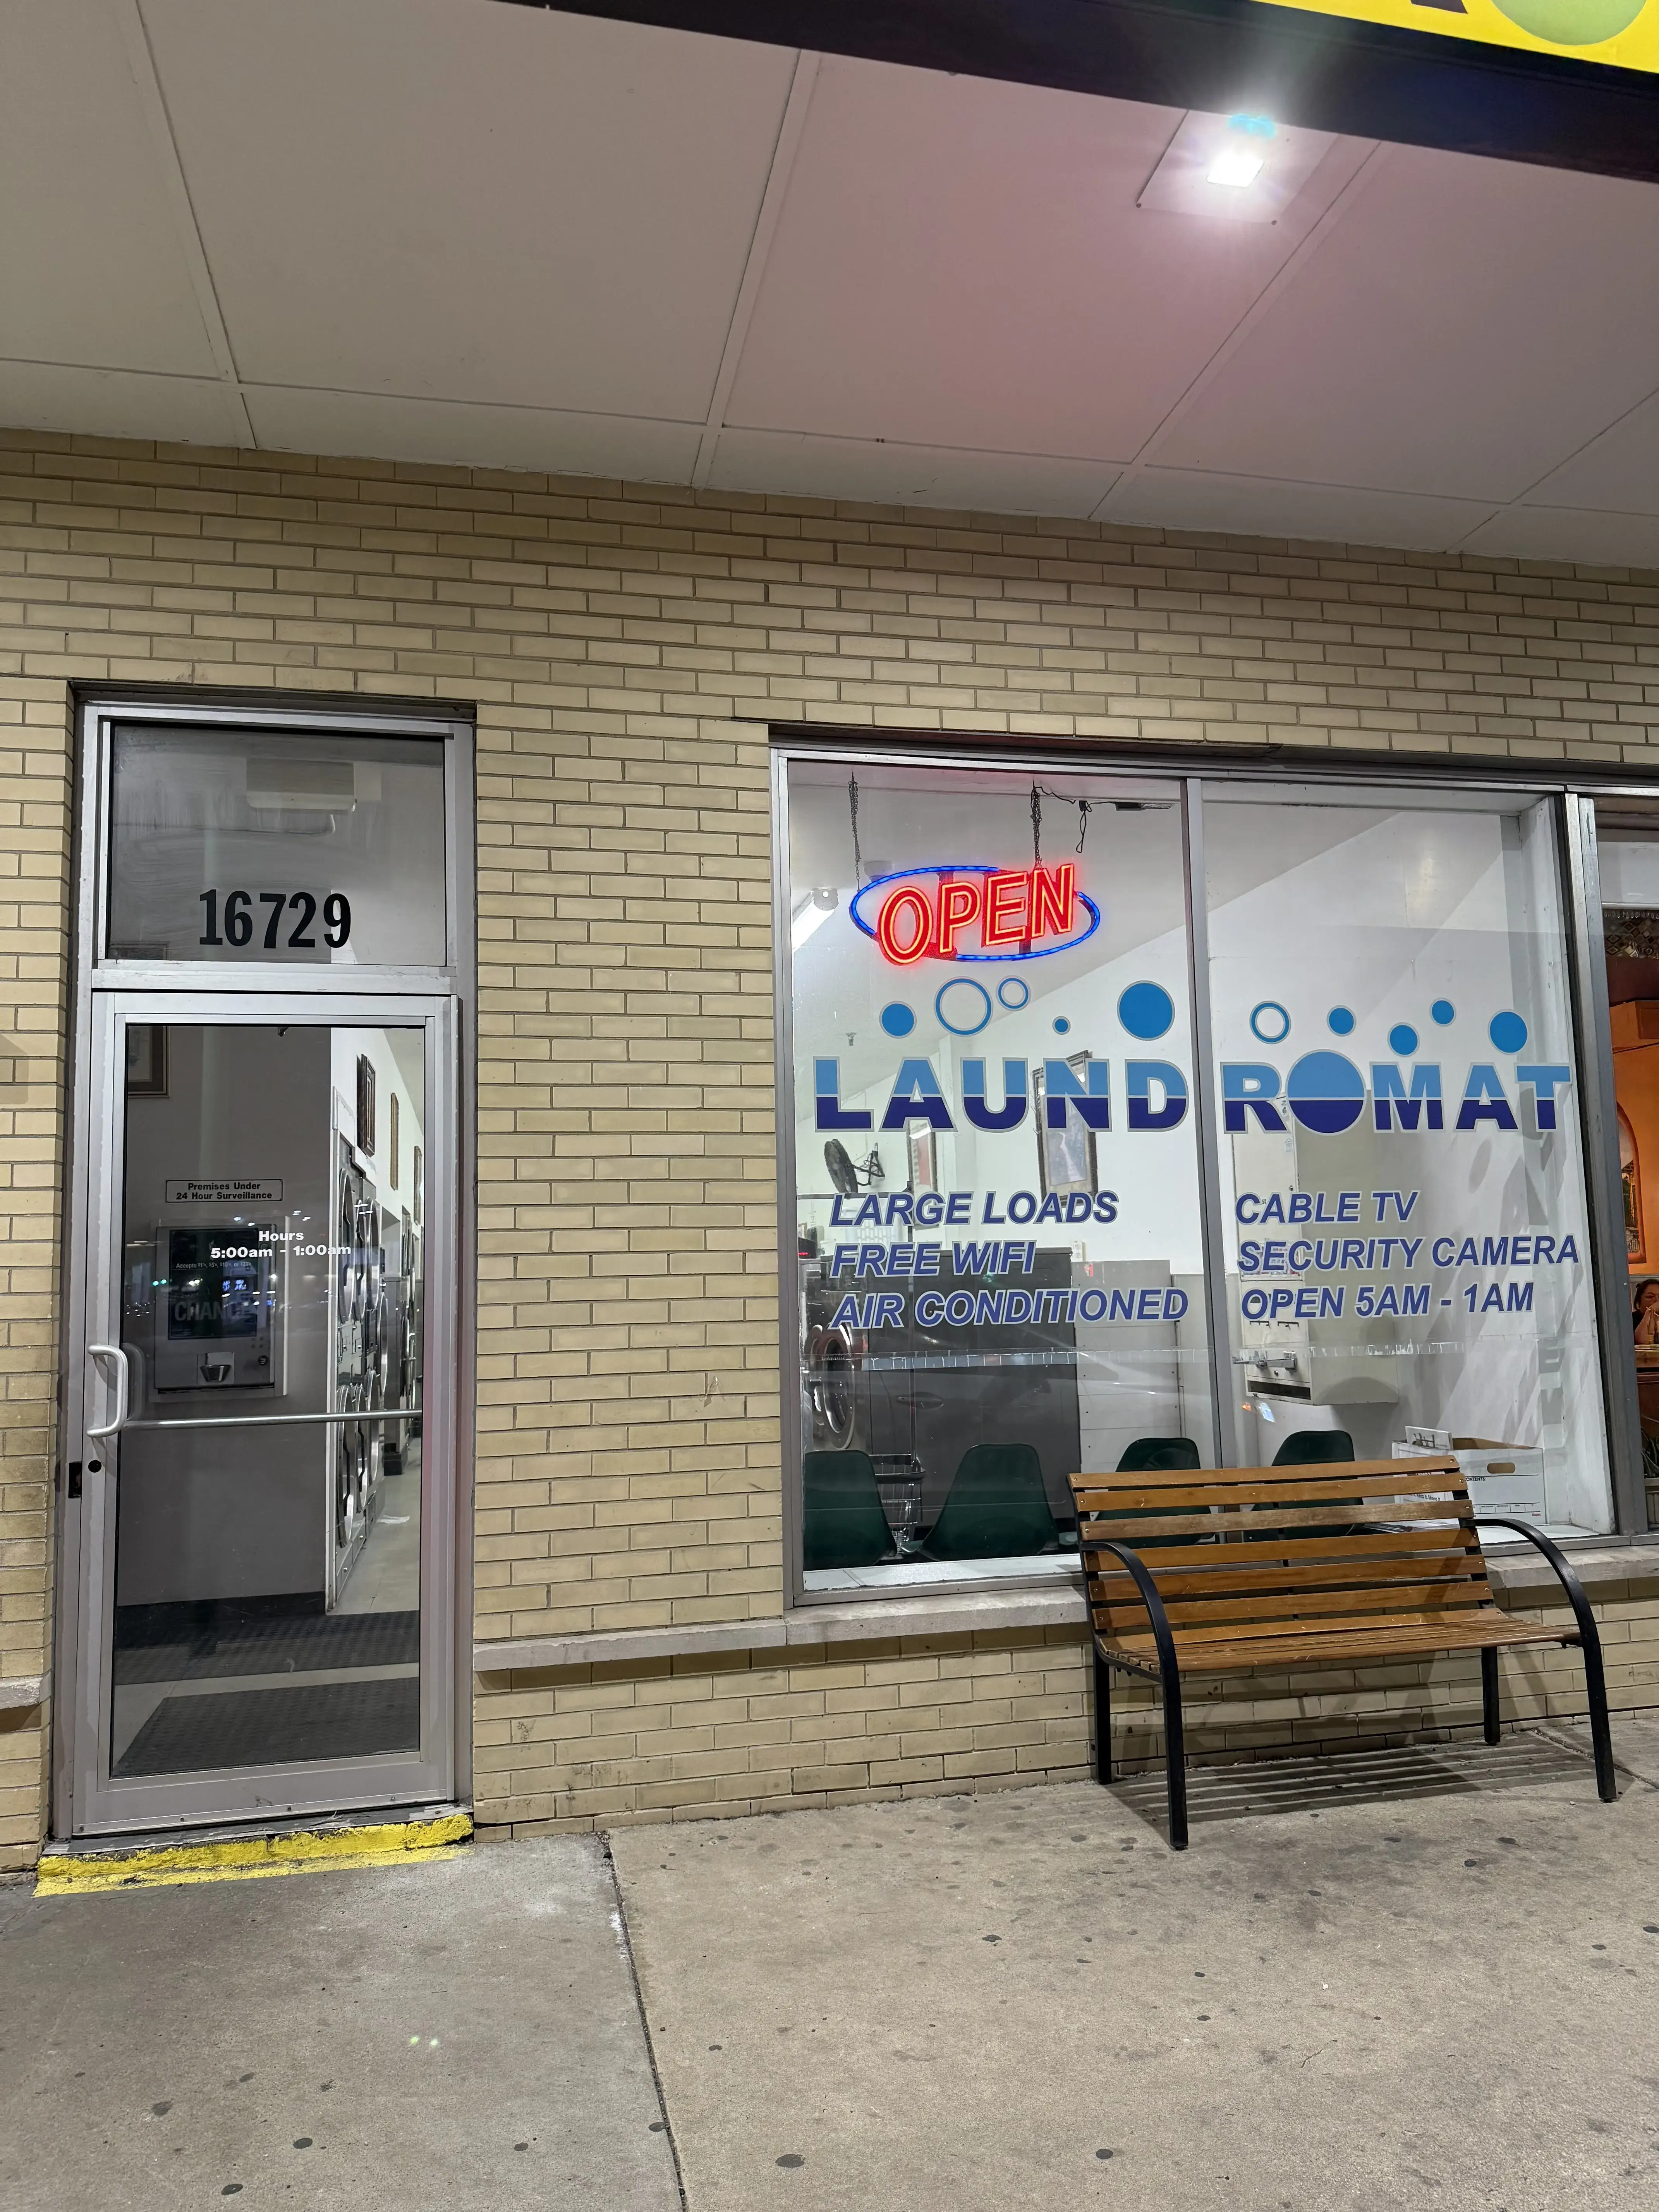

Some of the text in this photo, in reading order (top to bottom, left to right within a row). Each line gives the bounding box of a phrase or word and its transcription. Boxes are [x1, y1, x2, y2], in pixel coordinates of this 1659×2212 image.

[199, 889, 351, 948] 16729
[878, 864, 1074, 966] OPEN
[216, 1191, 272, 1199] Surveillance
[829, 1190, 1119, 1228] LARGE LOADS
[1235, 1190, 1420, 1225] CABLE TV
[211, 1247, 272, 1259] 5:00am
[293, 1244, 351, 1256] 1:00am
[259, 1230, 304, 1241] Hours
[1237, 1234, 1580, 1273] SECURITY CAMERA
[830, 1242, 942, 1278] FREE
[952, 1240, 1037, 1275] WIFI
[830, 1288, 1189, 1329] AIR CONDITIONED
[1240, 1282, 1534, 1321] OPEN 5AM - 1AM
